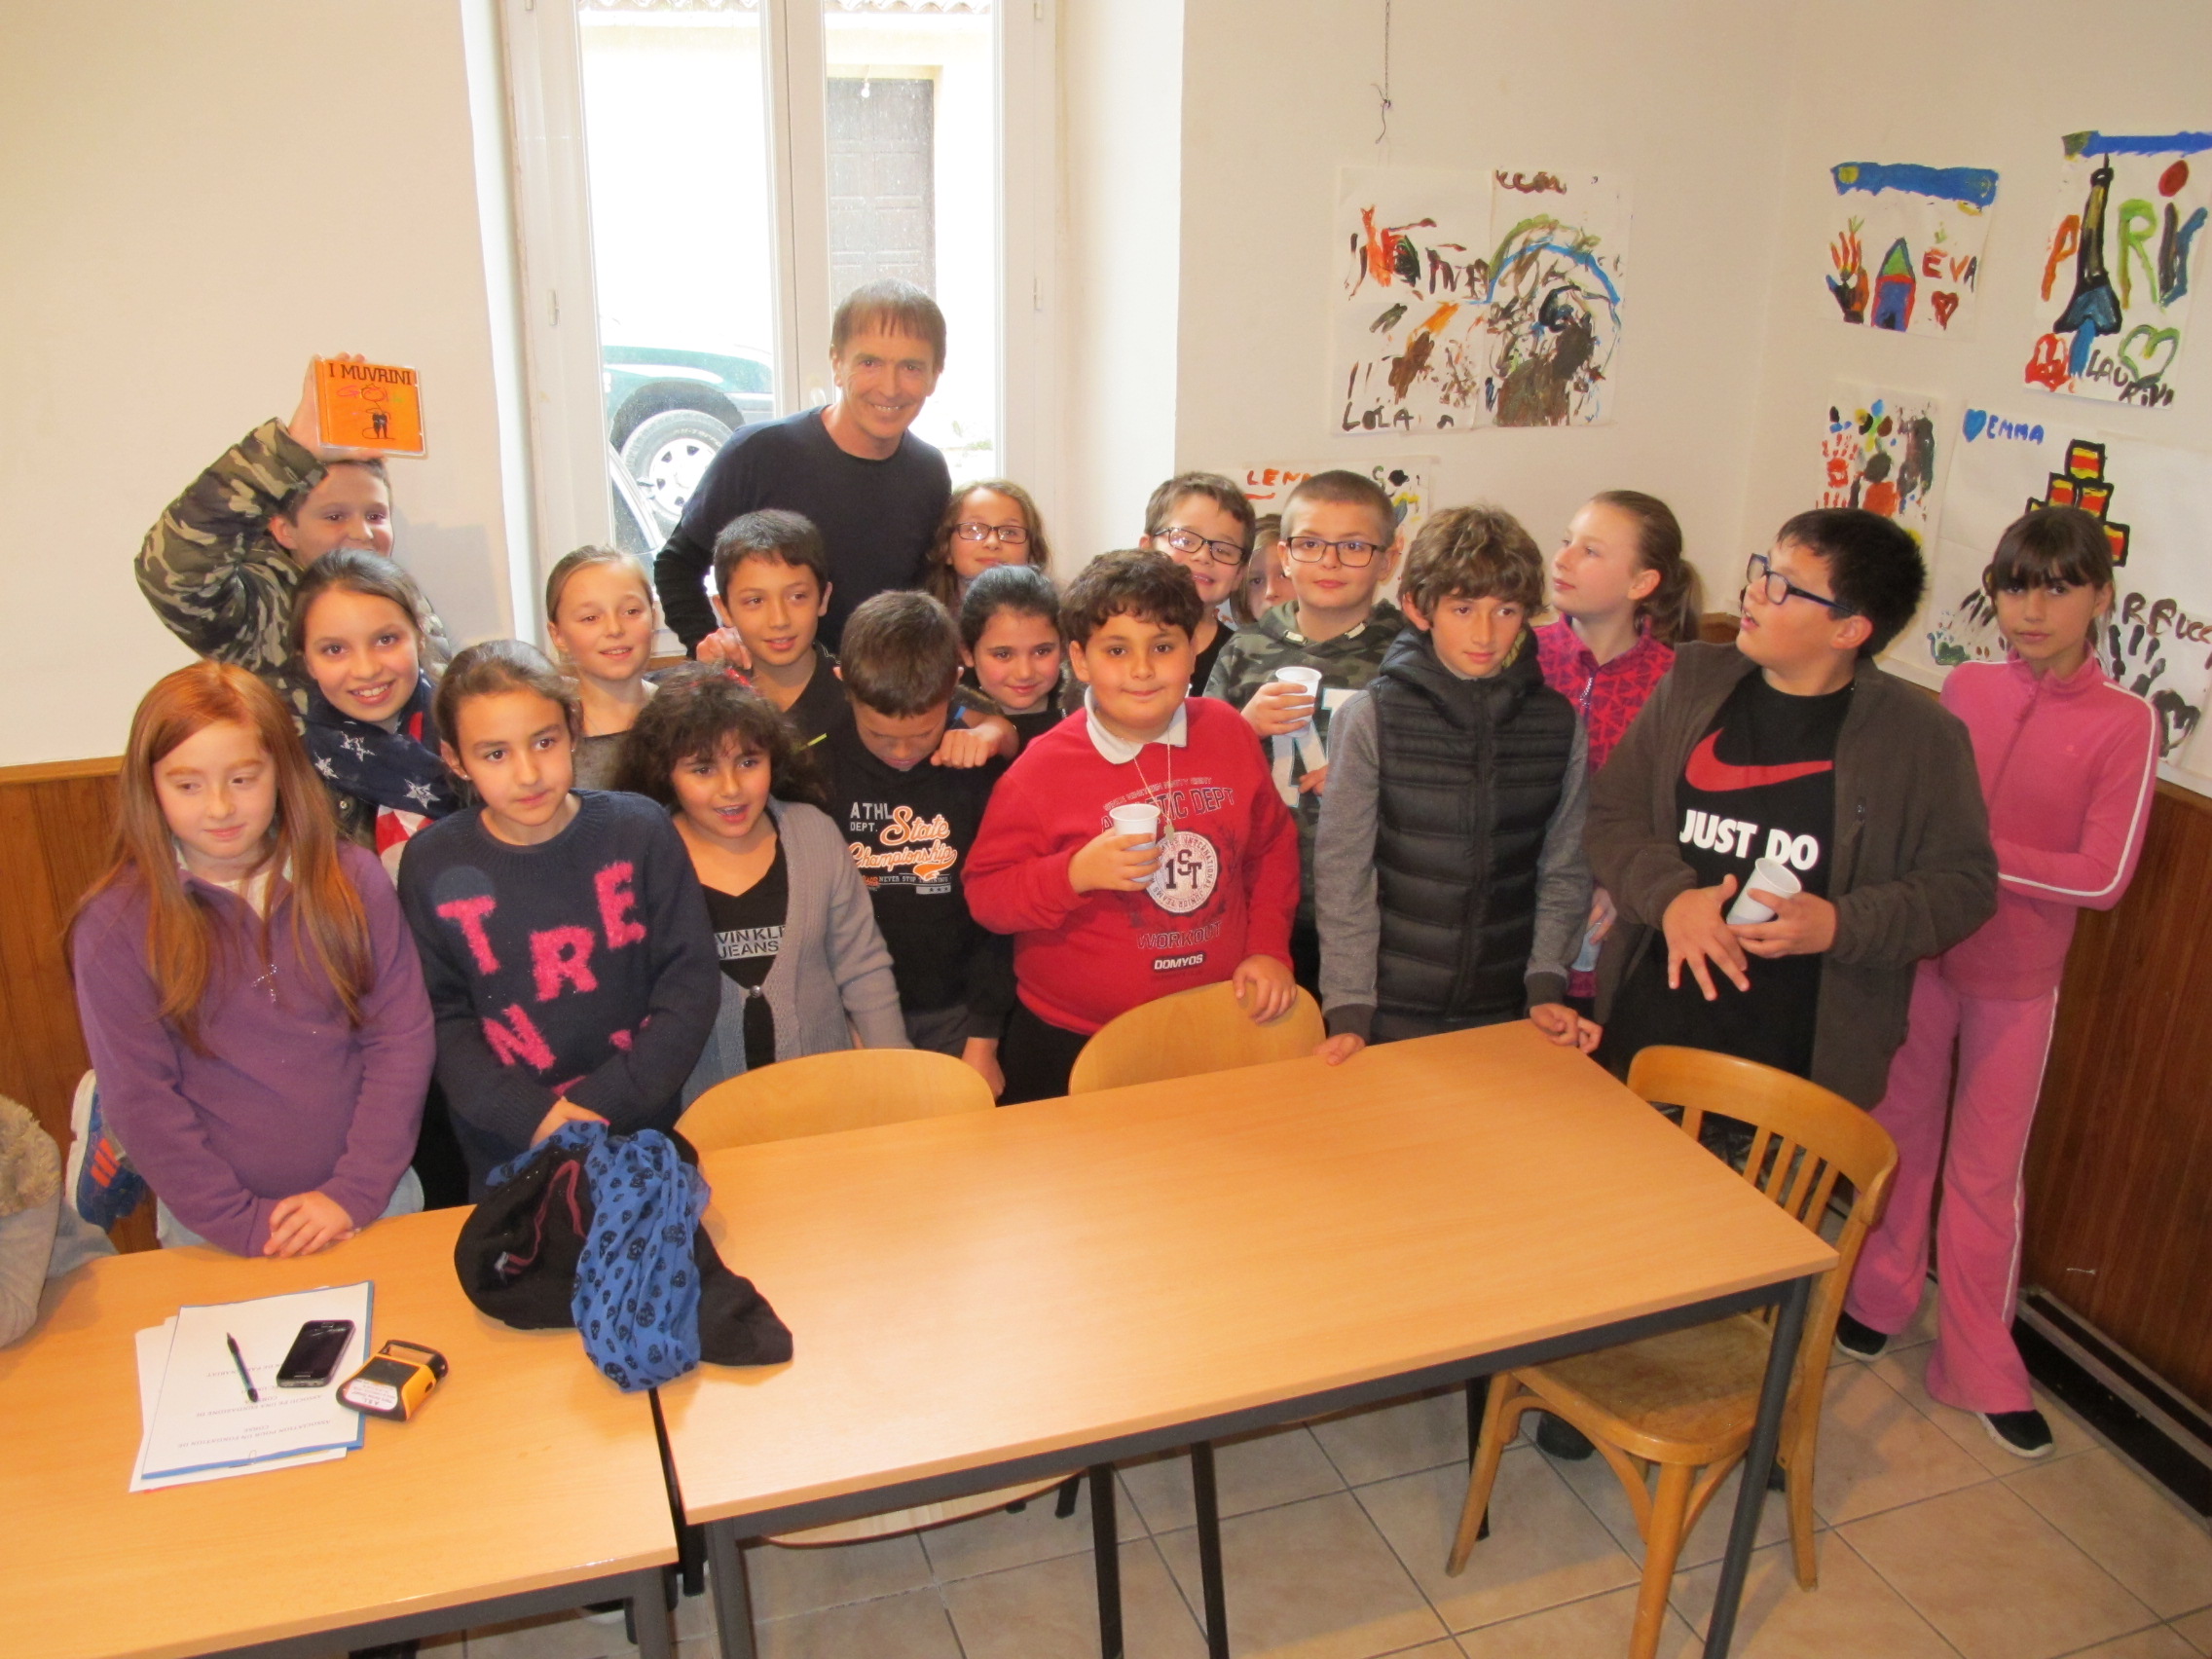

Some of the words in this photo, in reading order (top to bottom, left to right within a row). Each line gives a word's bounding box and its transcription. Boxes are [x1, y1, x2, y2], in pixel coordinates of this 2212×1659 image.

[1922, 247, 1977, 293] EVA
[328, 362, 335, 378] I
[341, 364, 413, 386] MUVRINI
[1342, 401, 1414, 431] LOLA
[1986, 415, 2045, 445] EMMA
[850, 801, 894, 820] ATHL
[1190, 787, 1235, 816] DEPT
[850, 822, 878, 832] DEPT.
[879, 805, 951, 846] State
[1679, 809, 1758, 859] JUST
[1764, 828, 1819, 871] DO
[848, 839, 958, 872] Championship
[720, 940, 779, 959] JEANS
[1137, 921, 1222, 949] WORKOUT
[1154, 954, 1204, 971] DOMYOS
